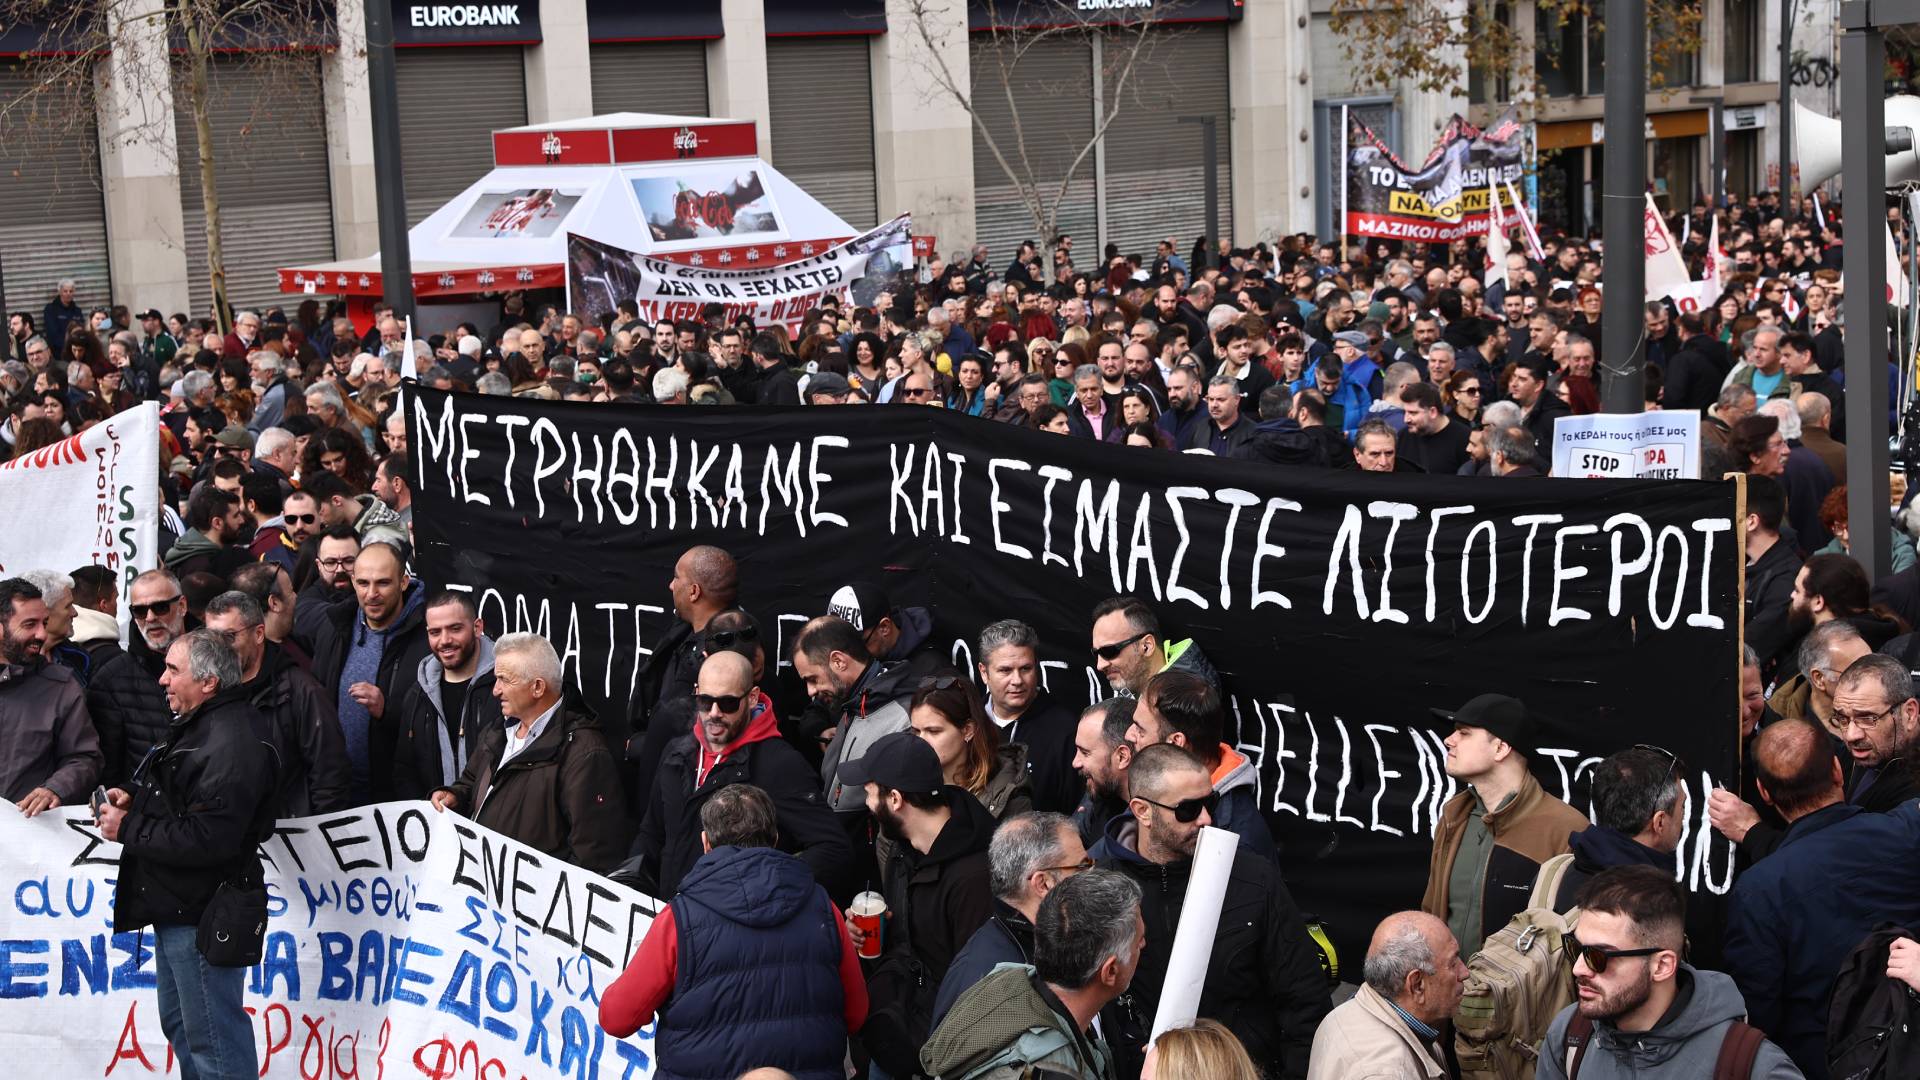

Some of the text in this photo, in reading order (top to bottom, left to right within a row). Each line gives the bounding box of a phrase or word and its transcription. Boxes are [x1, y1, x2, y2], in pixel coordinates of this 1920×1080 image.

[410, 5, 520, 27] EUROBANK
[1358, 219, 1436, 239] ΜΑΖΙΚΟΙ
[656, 278, 701, 297] ΔΕΝ
[705, 283, 737, 298] ΘΑ
[740, 266, 843, 297] ΞΕΧΑΣΤΕΙ
[640, 299, 659, 325] ΤΑ
[1562, 432, 1572, 442] Τα
[1574, 431, 1607, 441] ΚΕΡΔΗ
[1609, 432, 1633, 442] τους
[1667, 427, 1687, 437] μας
[1582, 454, 1620, 472] STOP
[414, 394, 1731, 630] ΜΕΤΡΗΘΗΚΑΜΕ ΚΑΙ ΕΙΜΑΣΤΕ ΛΙΓΟΤΕΡΟΙ
